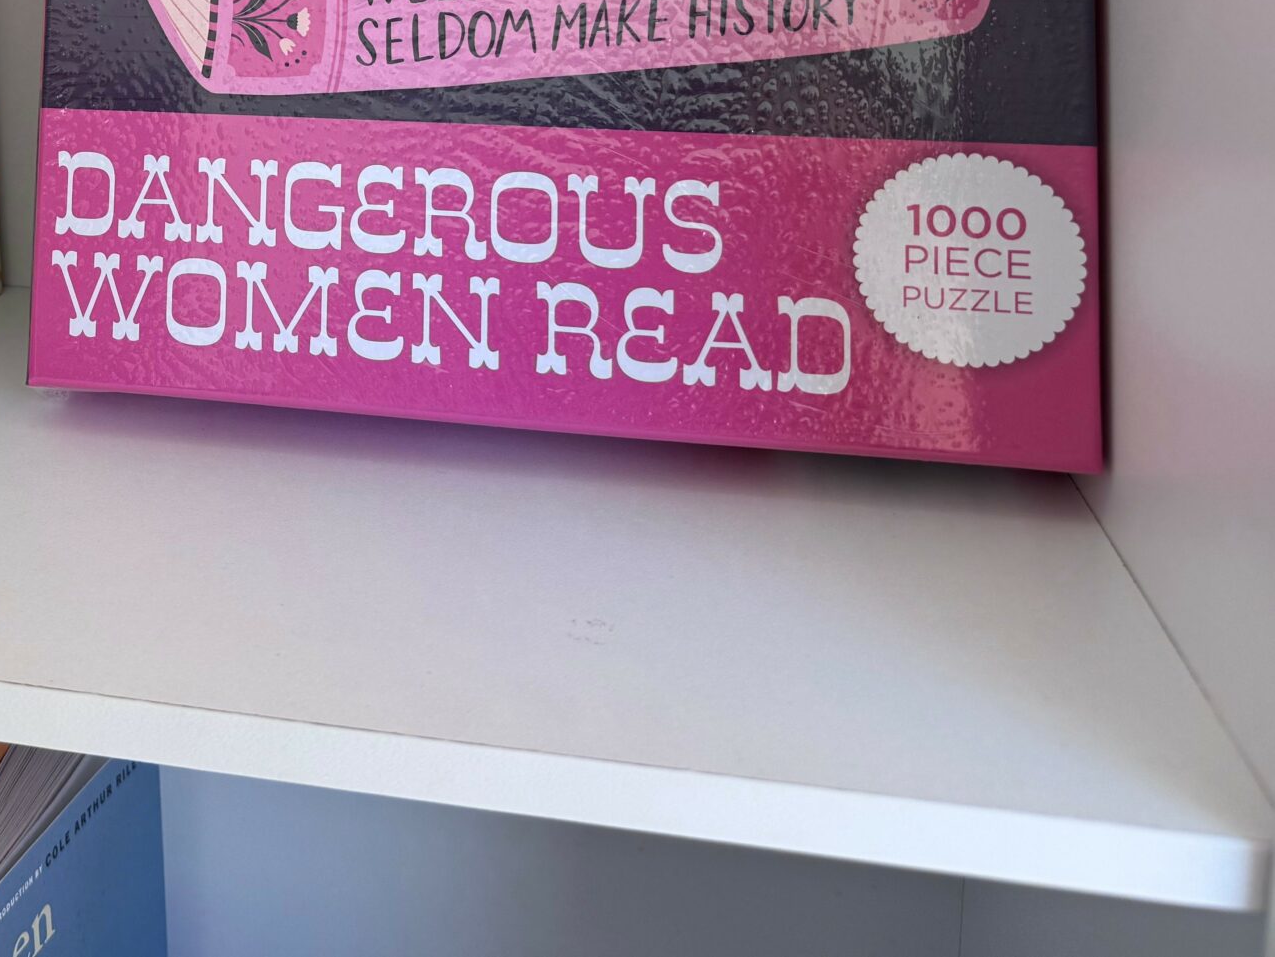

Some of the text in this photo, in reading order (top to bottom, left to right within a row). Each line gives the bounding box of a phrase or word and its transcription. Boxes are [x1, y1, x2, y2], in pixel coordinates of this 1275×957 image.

[356, 7, 537, 69] SELDOM
[56, 149, 724, 274] DANGEROUS
[906, 201, 1028, 242] 1000
[903, 245, 1032, 281] PIECE
[51, 248, 852, 395] WOMEN READ
[901, 284, 1033, 315] PUZZLE
[35, 864, 43, 879] BY
[45, 831, 71, 868] COLE
[74, 784, 113, 834] ARTHUR
